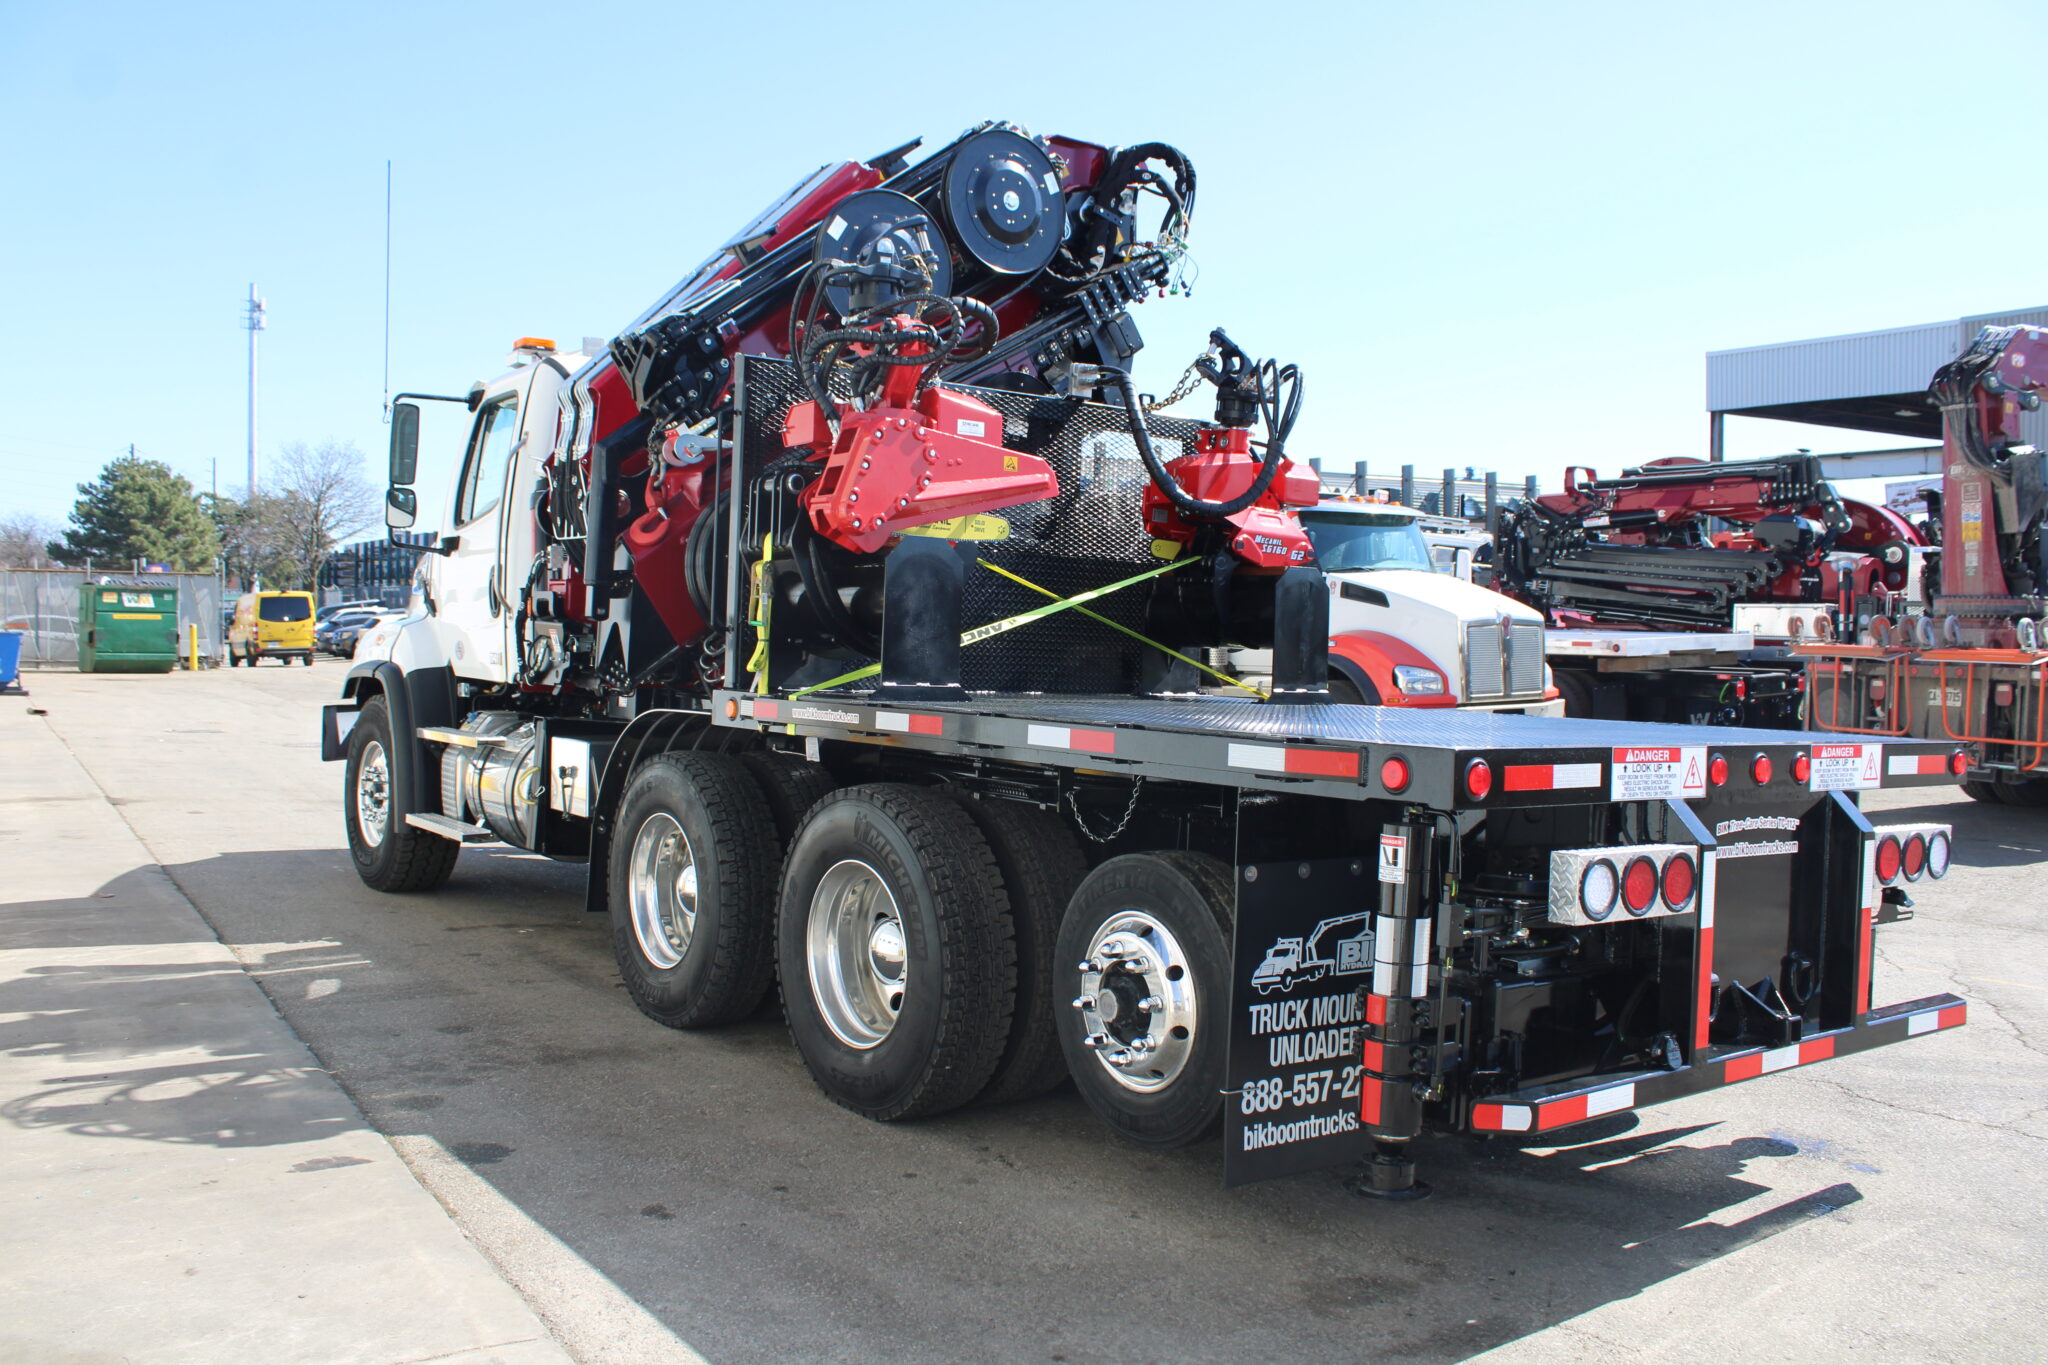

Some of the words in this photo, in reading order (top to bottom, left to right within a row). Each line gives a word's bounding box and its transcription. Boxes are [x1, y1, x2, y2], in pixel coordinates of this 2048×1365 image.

[1634, 750, 1670, 762] DANGER
[1827, 747, 1855, 757] DANGER
[1632, 763, 1651, 772] LOOK
[1653, 763, 1663, 772] UP
[1825, 759, 1840, 768] LOOK
[1759, 816, 1777, 829] Series
[866, 827, 929, 961] MICHELIN
[1249, 999, 1309, 1035] TRUCK
